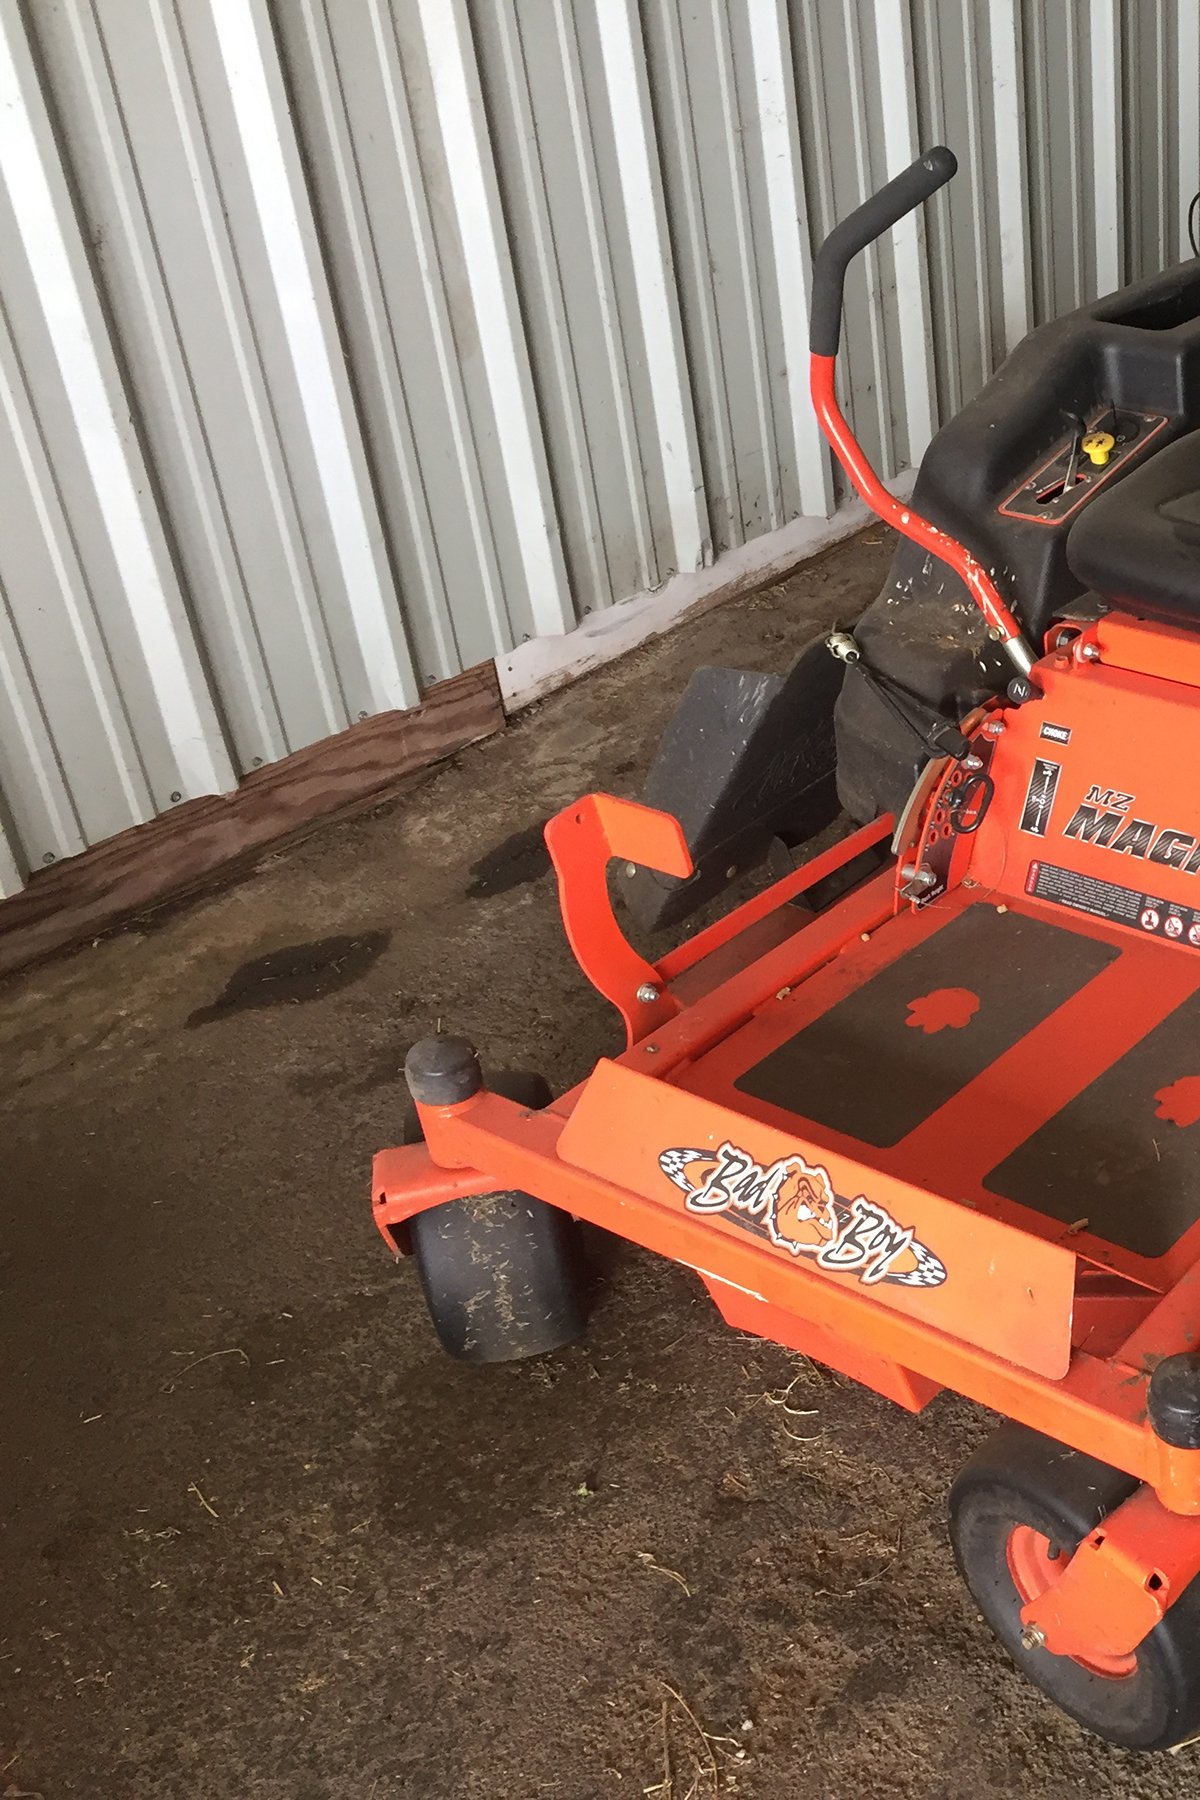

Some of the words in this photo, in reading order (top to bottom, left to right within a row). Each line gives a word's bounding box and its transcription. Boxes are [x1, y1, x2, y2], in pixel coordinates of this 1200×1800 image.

[1042, 726, 1069, 741] CHOKE
[1085, 785, 1135, 812] MZ
[687, 1144, 785, 1211] Bad
[818, 1198, 912, 1281] Boy
